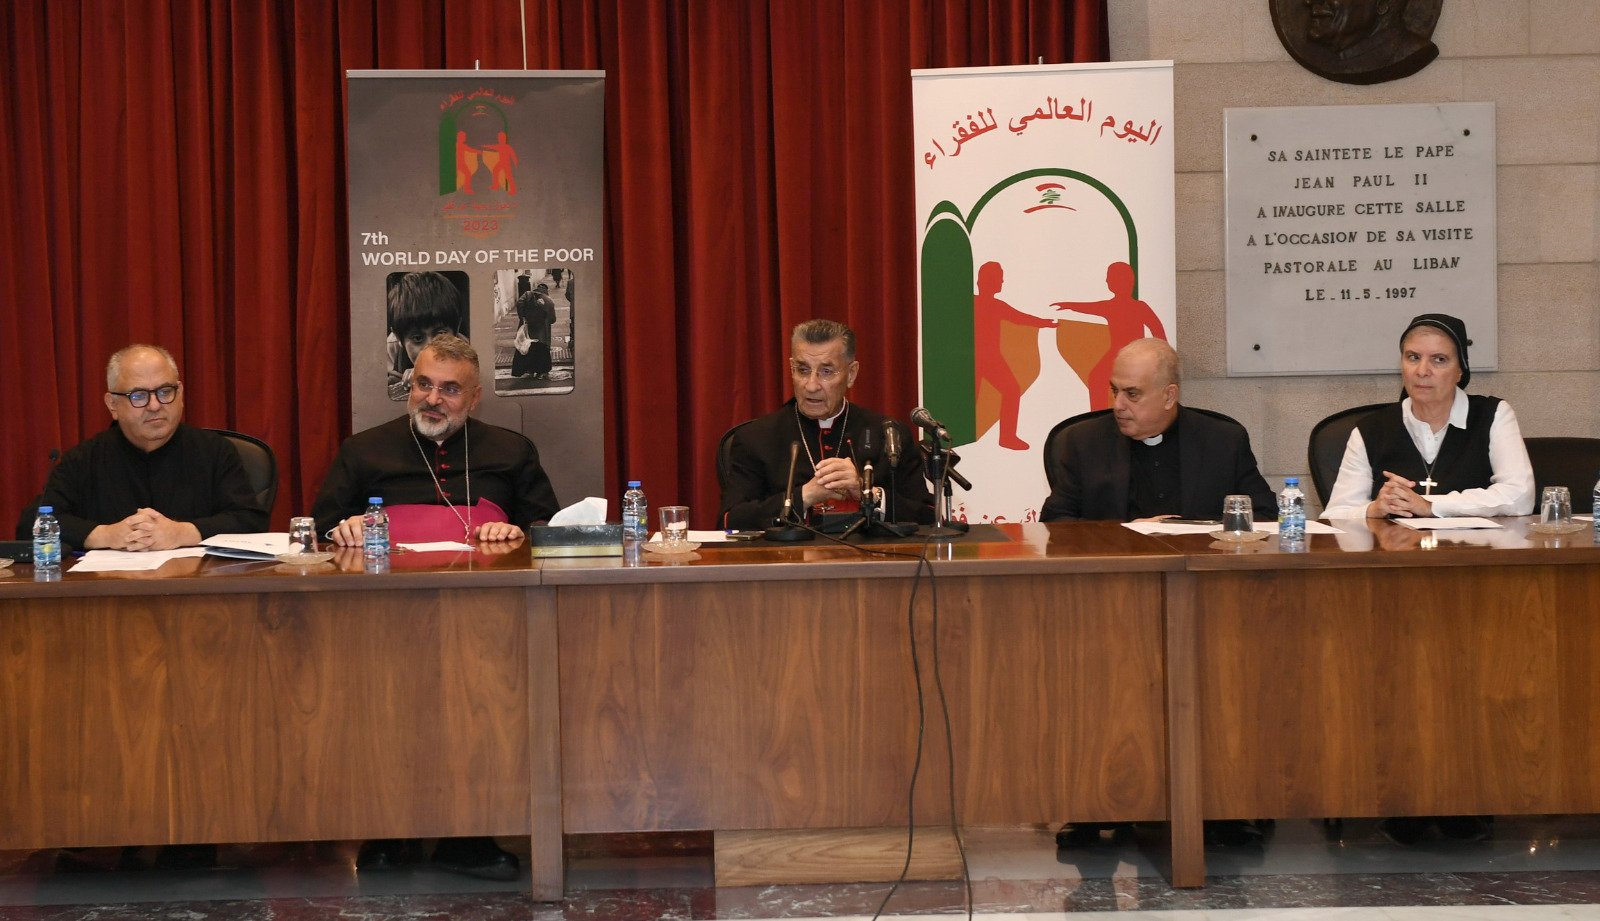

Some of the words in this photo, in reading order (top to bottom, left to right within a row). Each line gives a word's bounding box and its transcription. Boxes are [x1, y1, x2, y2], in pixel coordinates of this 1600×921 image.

[1007, 95, 1093, 137] العالمي
[923, 106, 999, 170] للفقراء
[1099, 115, 1163, 146] اليوم
[1267, 150, 1288, 162] SA
[1294, 147, 1372, 162] SAINTETE
[1384, 146, 1404, 159] LE
[1415, 145, 1455, 158] PAPE
[1294, 176, 1335, 189] JEAN
[1353, 174, 1395, 188] PAUL
[1414, 173, 1428, 186] II
[1256, 206, 1267, 219] A
[1272, 203, 1346, 218] INAUGURE
[1354, 201, 1404, 216] CETTE
[1415, 200, 1466, 214] SALLE
[463, 219, 498, 231] 2023
[361, 231, 389, 246] 7th
[1246, 234, 1257, 247] A
[1264, 231, 1358, 246] L'OCCASION
[1366, 230, 1387, 243] DE
[1395, 229, 1416, 242] SA
[1421, 227, 1473, 241] VISITE
[361, 251, 431, 266] WORLD
[435, 250, 471, 265] DAY
[475, 249, 500, 264] OF
[503, 249, 539, 263] THE
[544, 248, 594, 263] POOR
[1263, 259, 1358, 274] PASTORALE
[1373, 258, 1393, 271] AU
[1412, 256, 1461, 270] LIBAN
